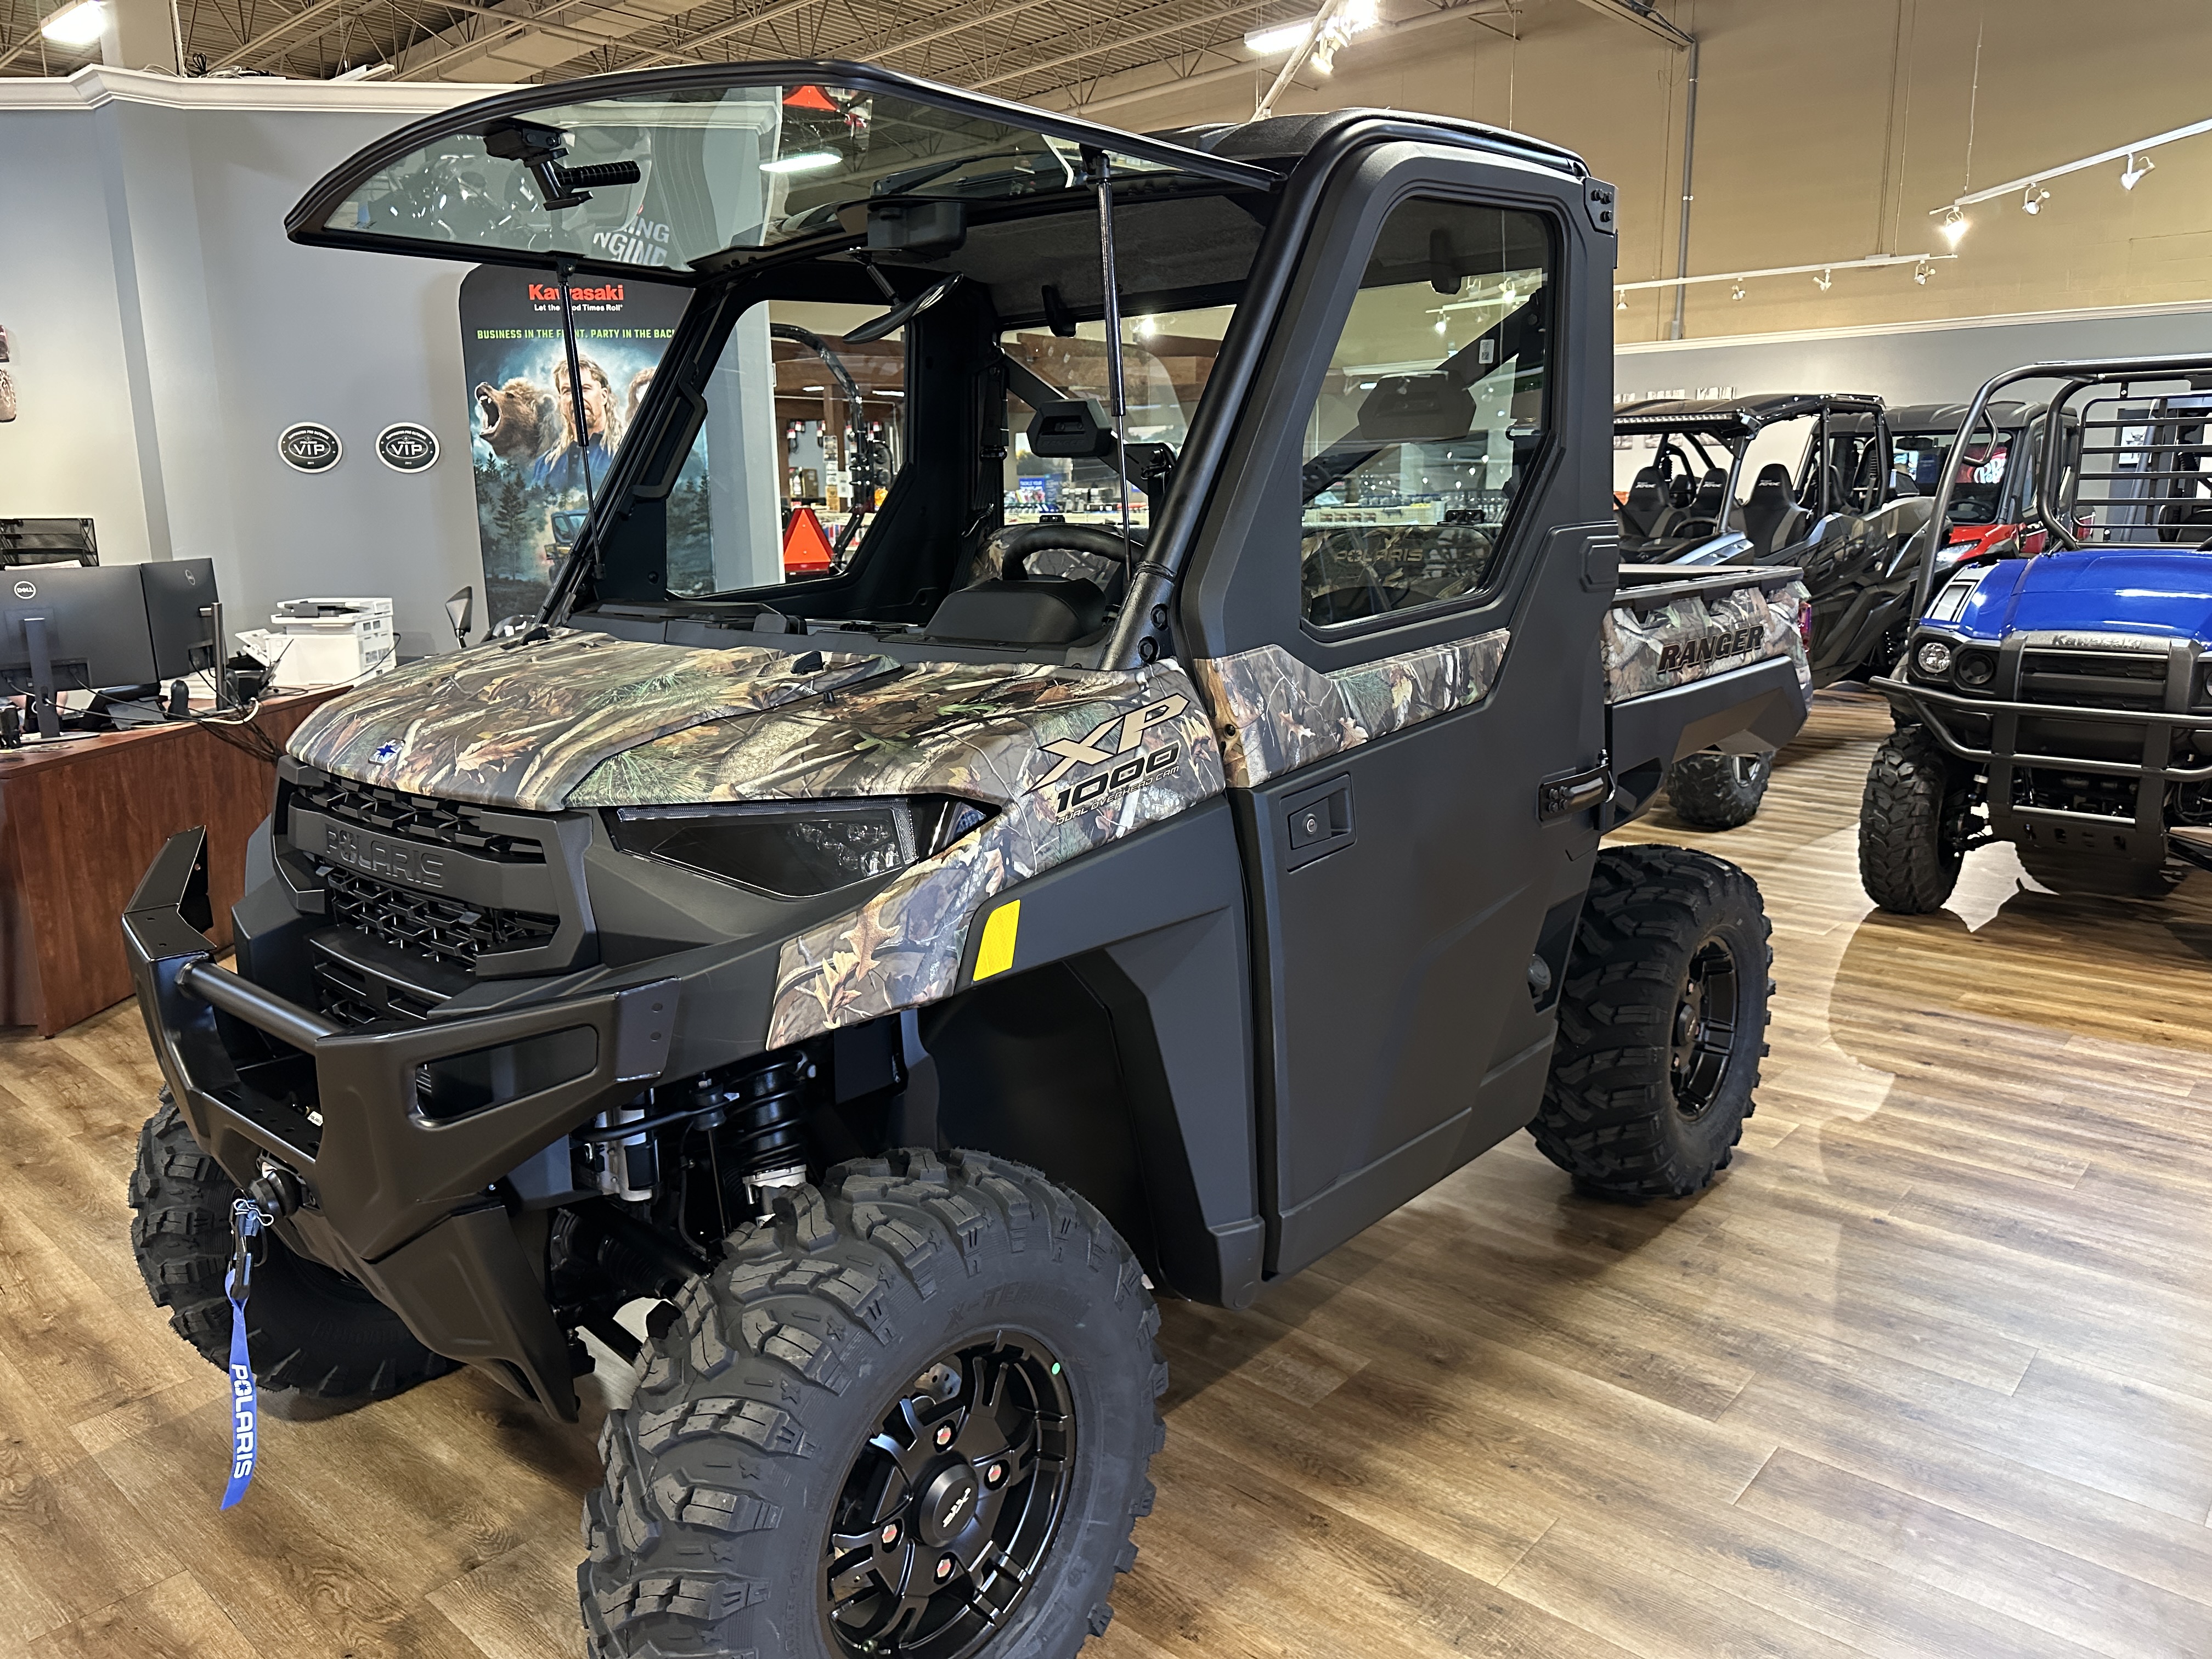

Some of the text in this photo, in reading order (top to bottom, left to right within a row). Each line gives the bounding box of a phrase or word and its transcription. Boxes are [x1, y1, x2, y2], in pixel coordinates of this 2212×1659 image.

[477, 329, 522, 339] BUSINESS
[524, 329, 534, 338] IN
[536, 329, 555, 338] THE
[556, 329, 588, 338] FNT.
[591, 329, 620, 338] PARTY
[622, 329, 632, 338] IN
[634, 329, 652, 338] THE
[292, 444, 325, 455] VIP
[390, 444, 423, 455] VIP
[1334, 549, 1423, 562] POLARIS
[1656, 624, 1765, 674] RANGER
[2052, 634, 2142, 650] Kawasaki
[1019, 692, 1190, 798] XP
[1055, 739, 1181, 817] 1000
[1056, 765, 1180, 826] DUAL OVERHEAD CAM
[325, 823, 444, 888] POLARIS
[230, 1364, 253, 1479] POLARIS
